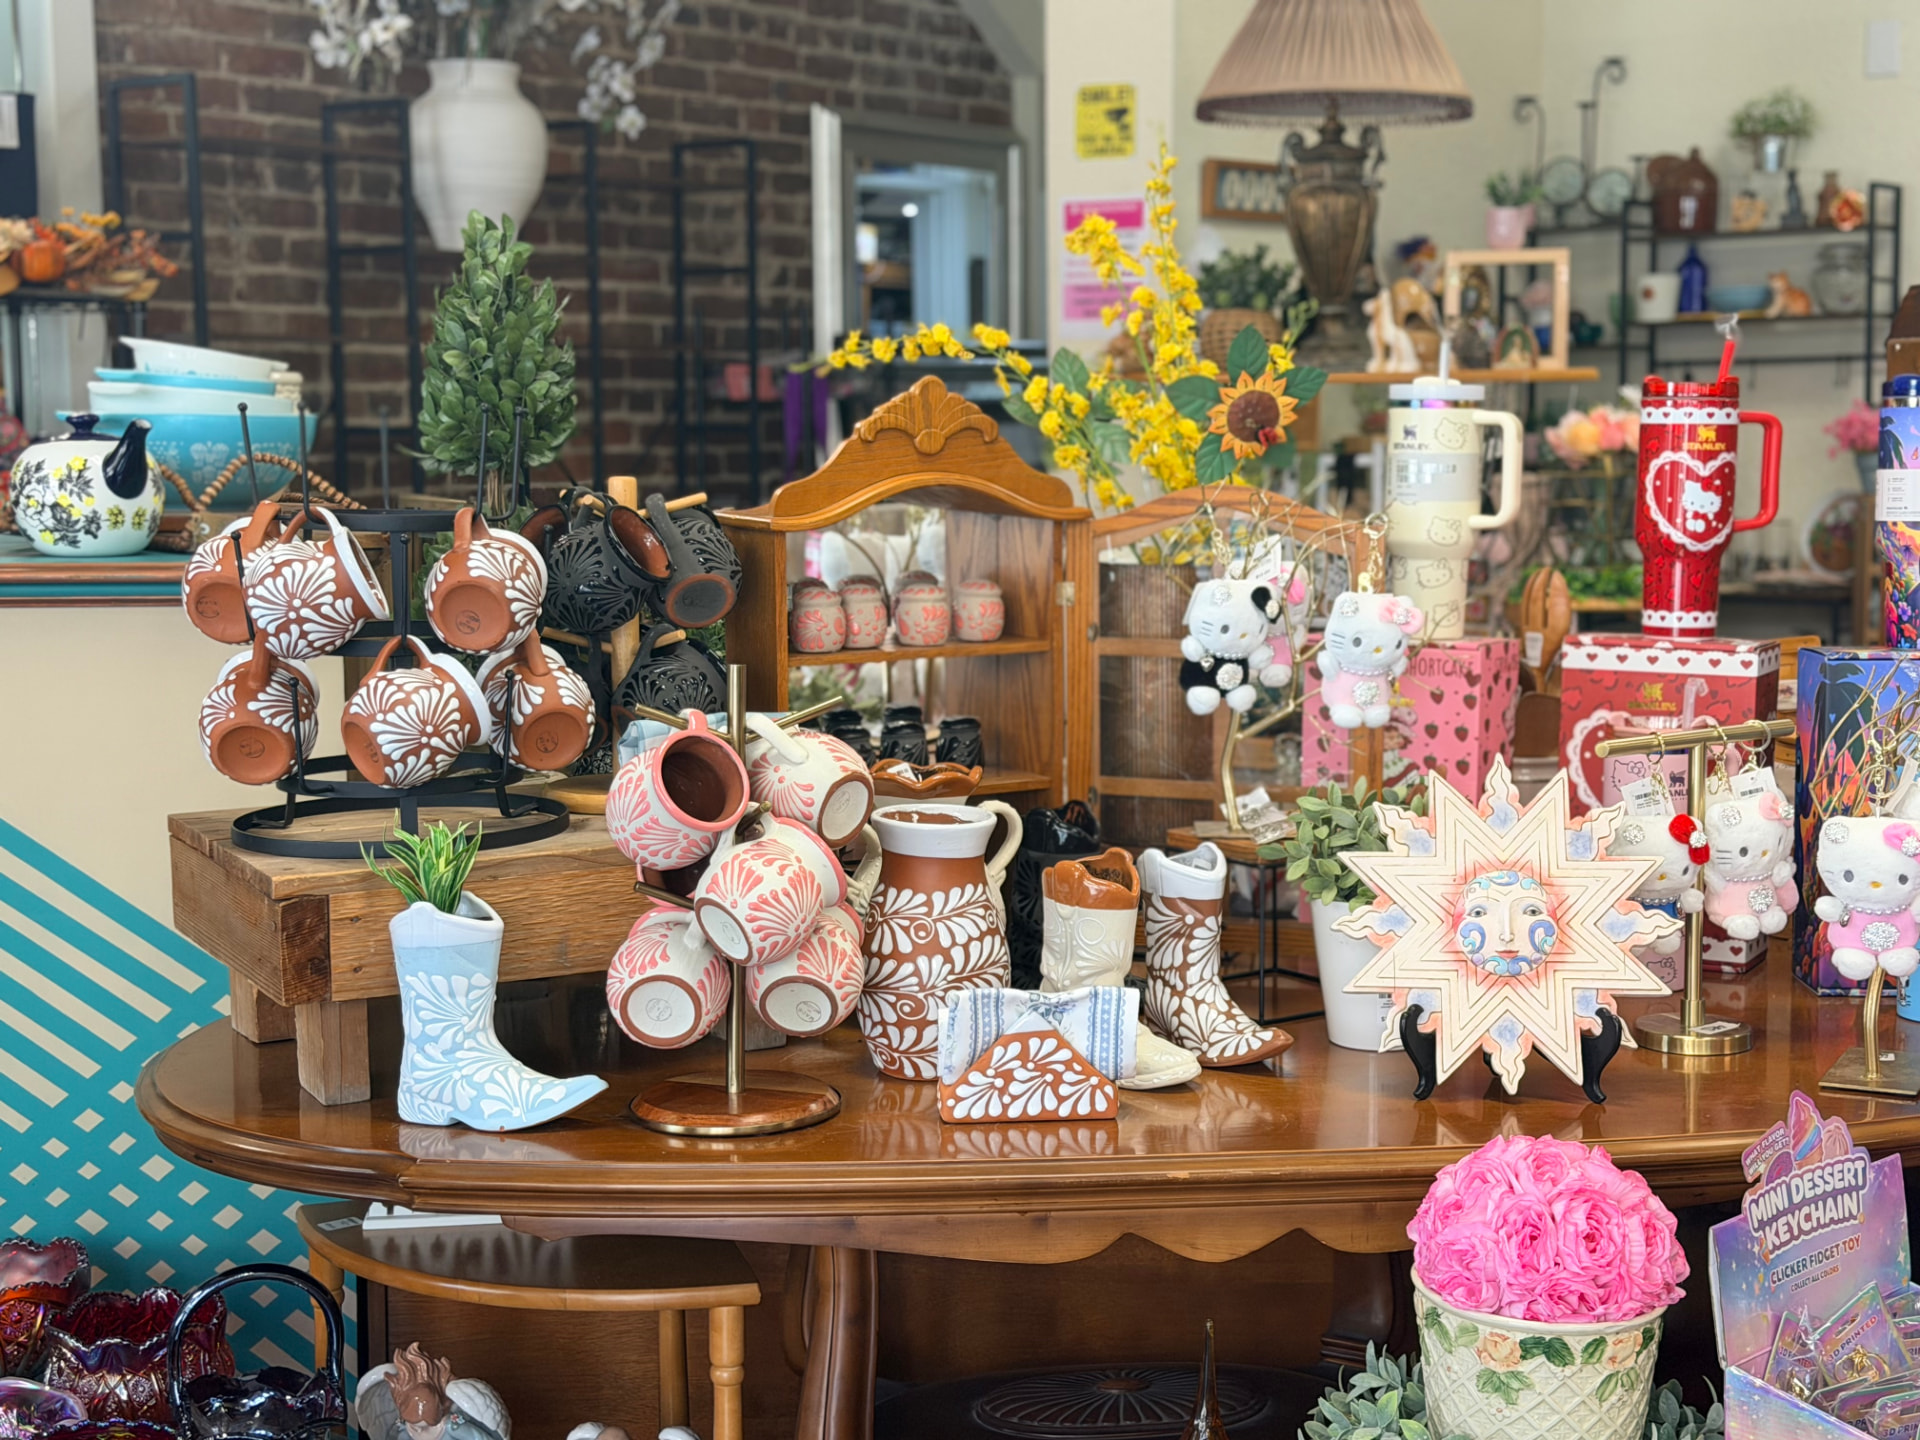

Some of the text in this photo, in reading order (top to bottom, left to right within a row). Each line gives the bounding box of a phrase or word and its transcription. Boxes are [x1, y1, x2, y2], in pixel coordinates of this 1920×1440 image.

[1393, 442, 1430, 451] STANLEY
[1682, 442, 1727, 451] STANLEY
[1745, 1127, 1786, 1166] WHAT FLAVOR
[1748, 1137, 1791, 1176] WILL YOU GET?
[1750, 1160, 1865, 1229] MINI DESSERT
[1764, 1191, 1858, 1250] KEYCHAIN
[1770, 1235, 1861, 1285] CLICKER FIDGET TOY
[1790, 1265, 1840, 1292] COLLECT ALL COLORS
[1840, 1316, 1878, 1351] PRINTED
[1898, 1423, 1918, 1434] PRIN
